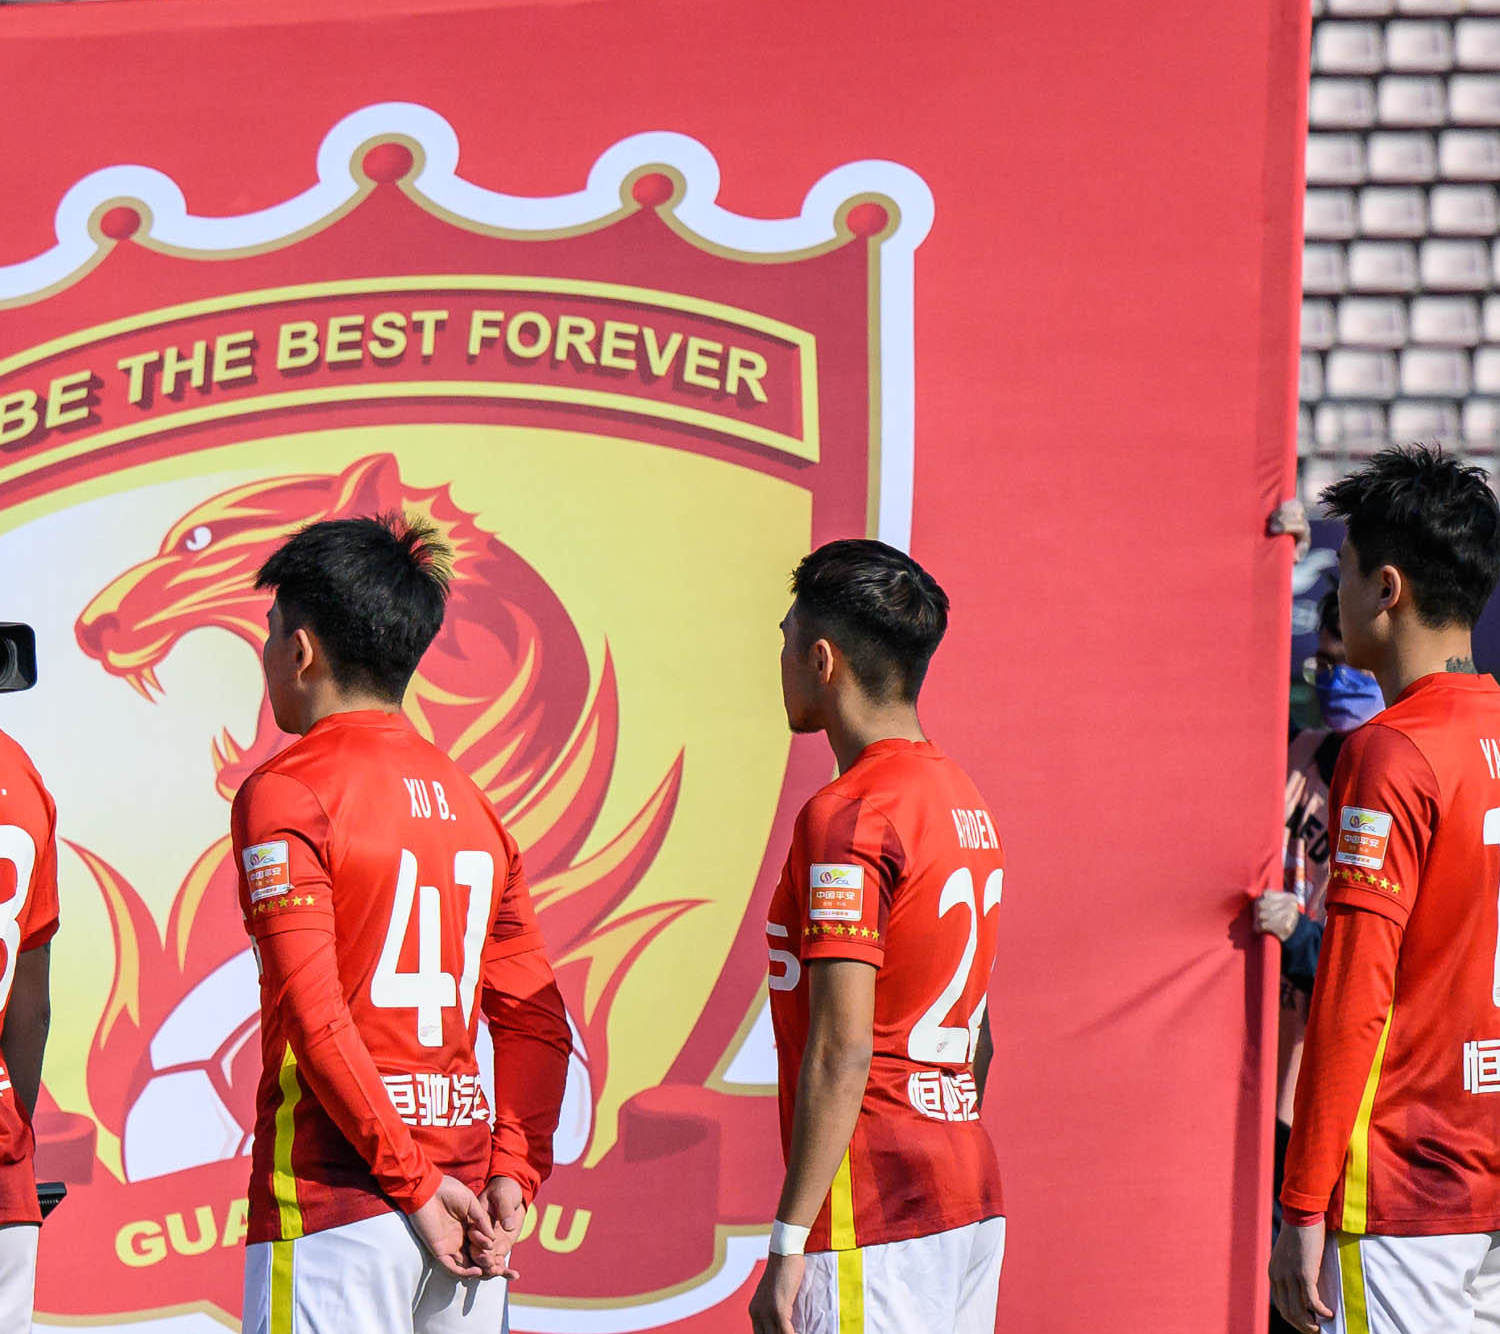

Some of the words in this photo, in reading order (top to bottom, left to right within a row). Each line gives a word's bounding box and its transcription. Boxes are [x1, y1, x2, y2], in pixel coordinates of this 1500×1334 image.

[118, 330, 260, 405] THE
[276, 308, 449, 372] BEST
[466, 309, 770, 404] FOREVER
[402, 777, 432, 820] XU
[432, 780, 457, 823] B.
[370, 848, 495, 1048] 47
